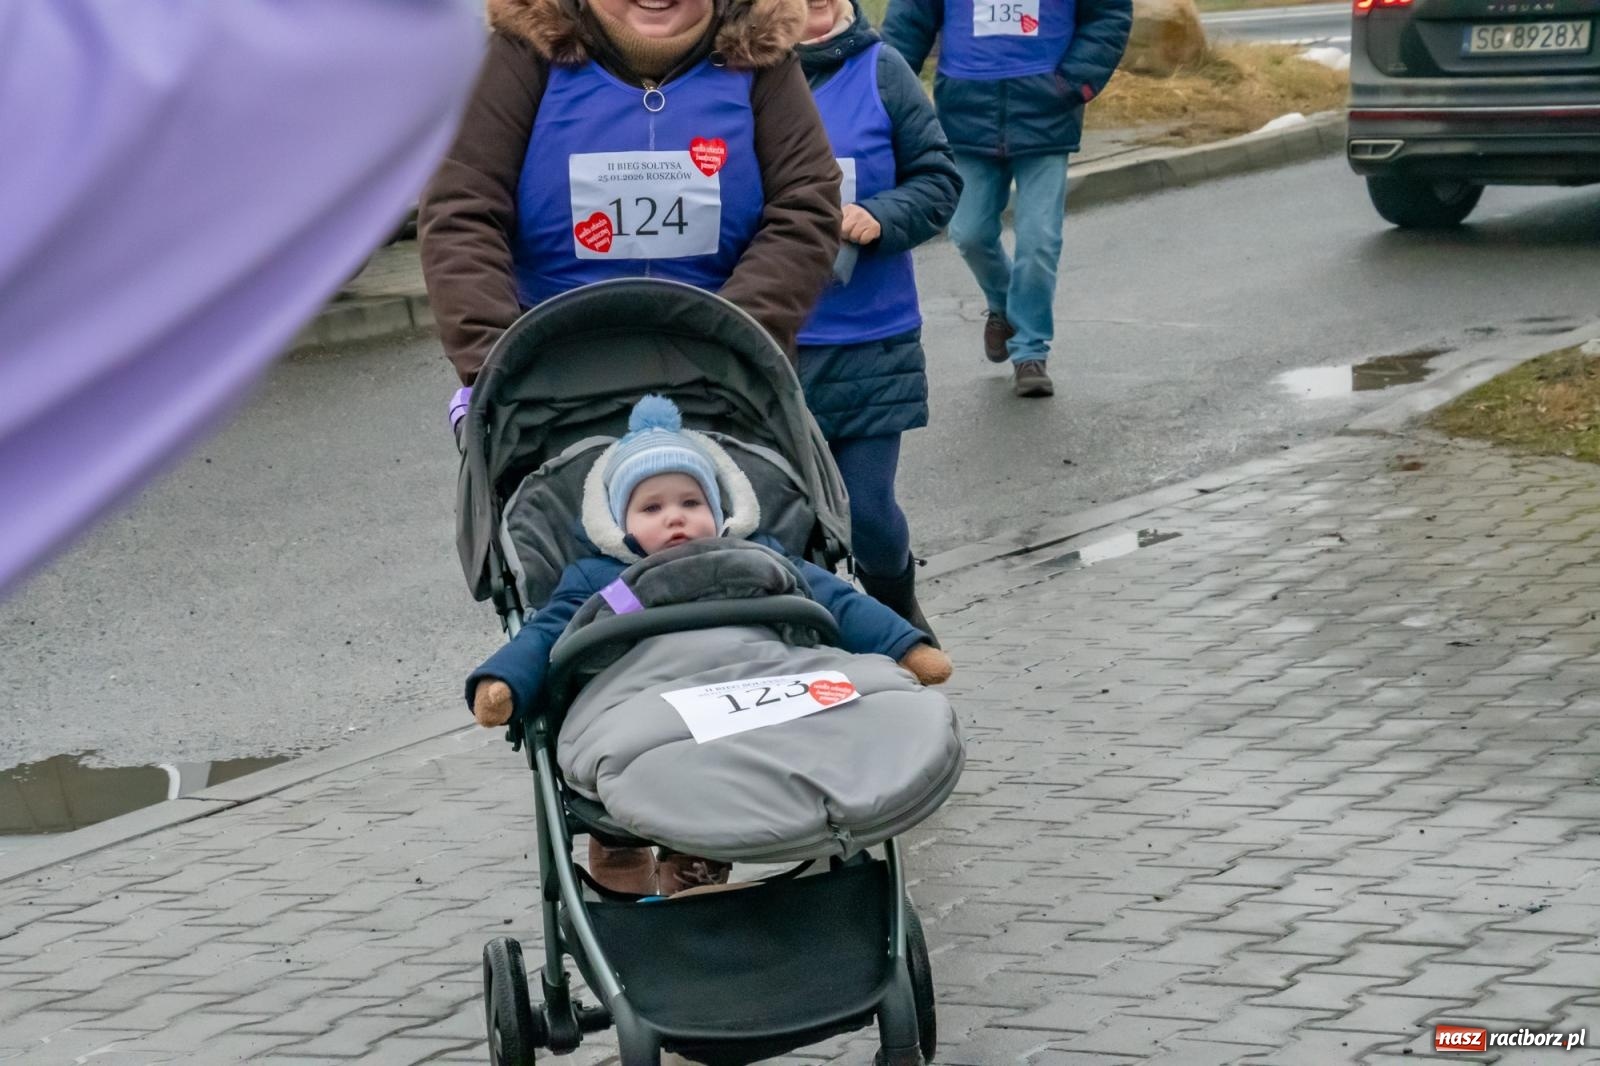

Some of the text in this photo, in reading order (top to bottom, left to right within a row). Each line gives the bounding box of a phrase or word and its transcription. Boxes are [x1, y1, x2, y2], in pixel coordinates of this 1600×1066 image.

[988, 3, 1023, 22] 135
[1476, 23, 1583, 49] SG 8928X
[598, 170, 692, 182] 25.01.2026 ROSZKÓW
[608, 162, 615, 171] II
[617, 161, 640, 171] BIEG
[609, 196, 688, 236] 124
[717, 680, 809, 714] 123
